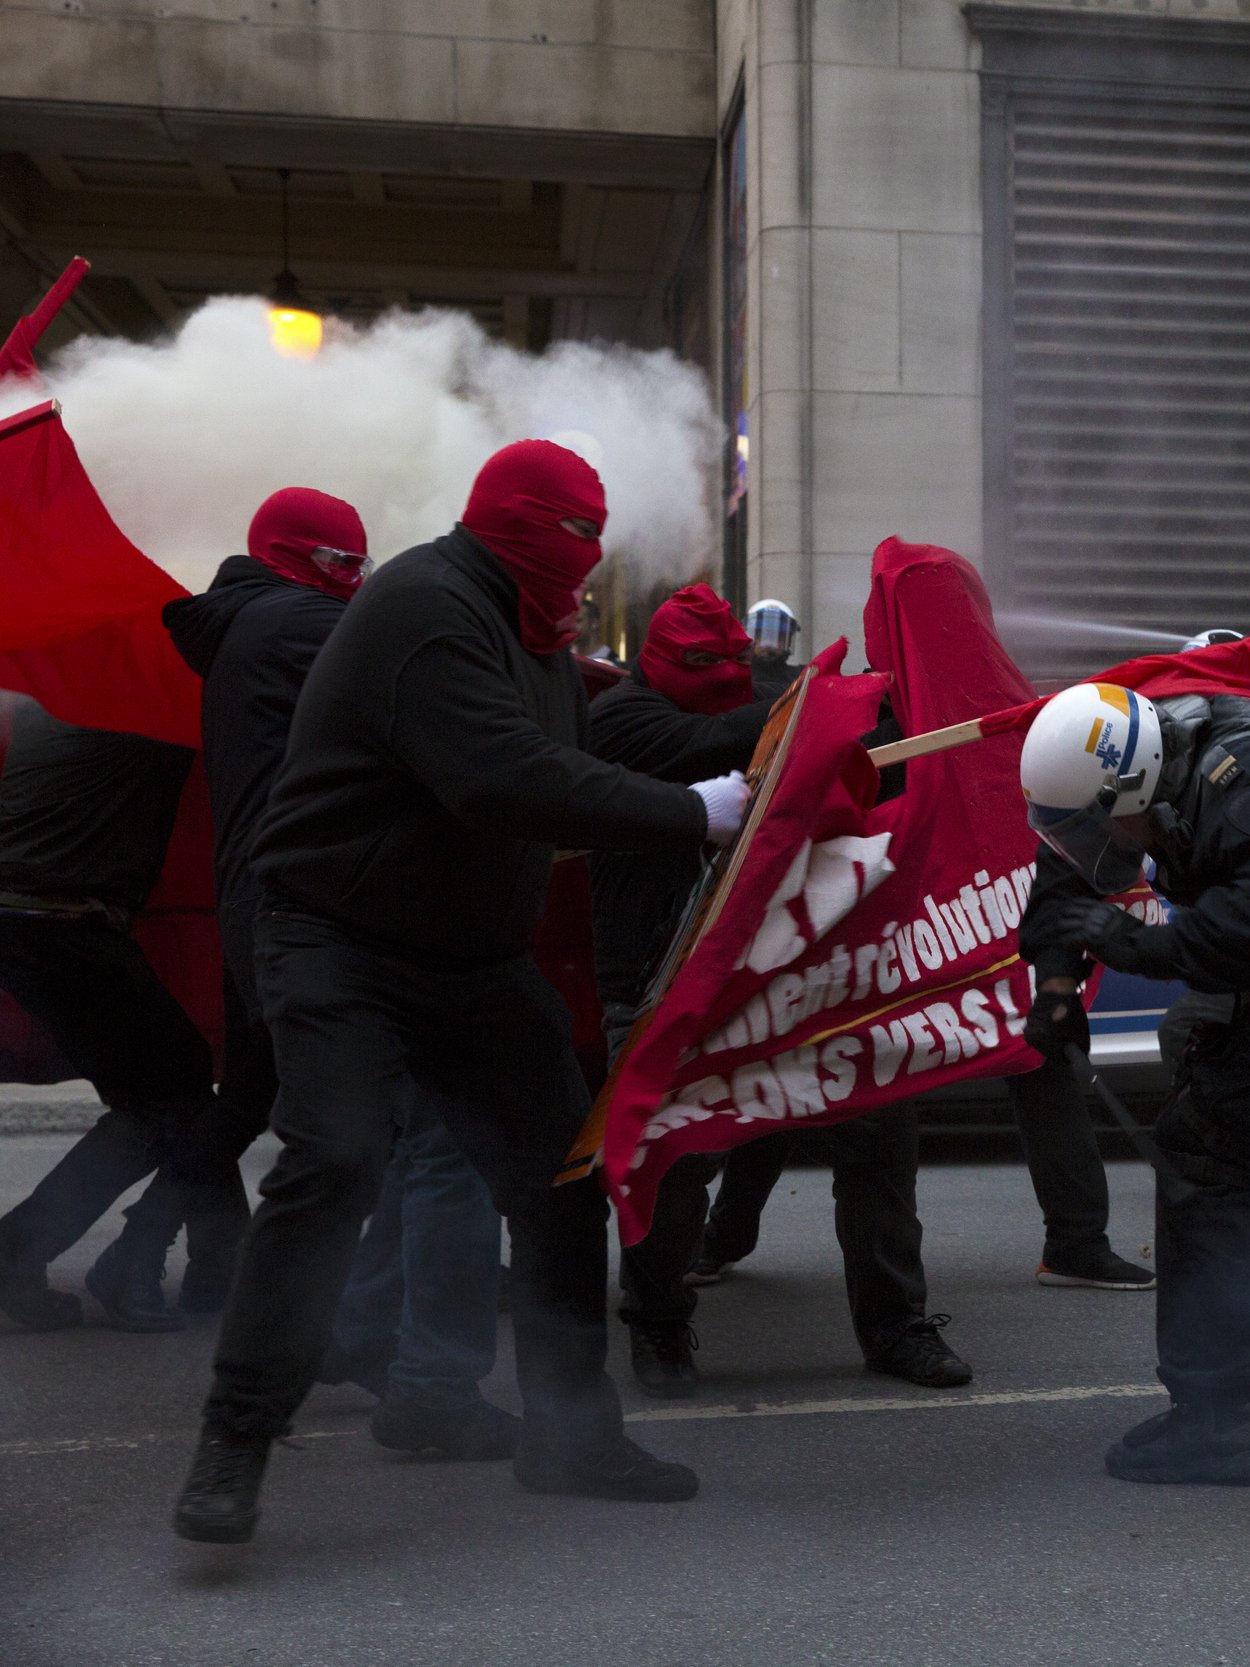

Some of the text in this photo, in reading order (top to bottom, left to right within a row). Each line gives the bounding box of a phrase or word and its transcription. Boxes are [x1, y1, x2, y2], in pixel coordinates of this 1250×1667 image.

[1099, 722, 1113, 750] Police
[852, 862, 1037, 1003] révolution
[870, 988, 1000, 1088] VERS
